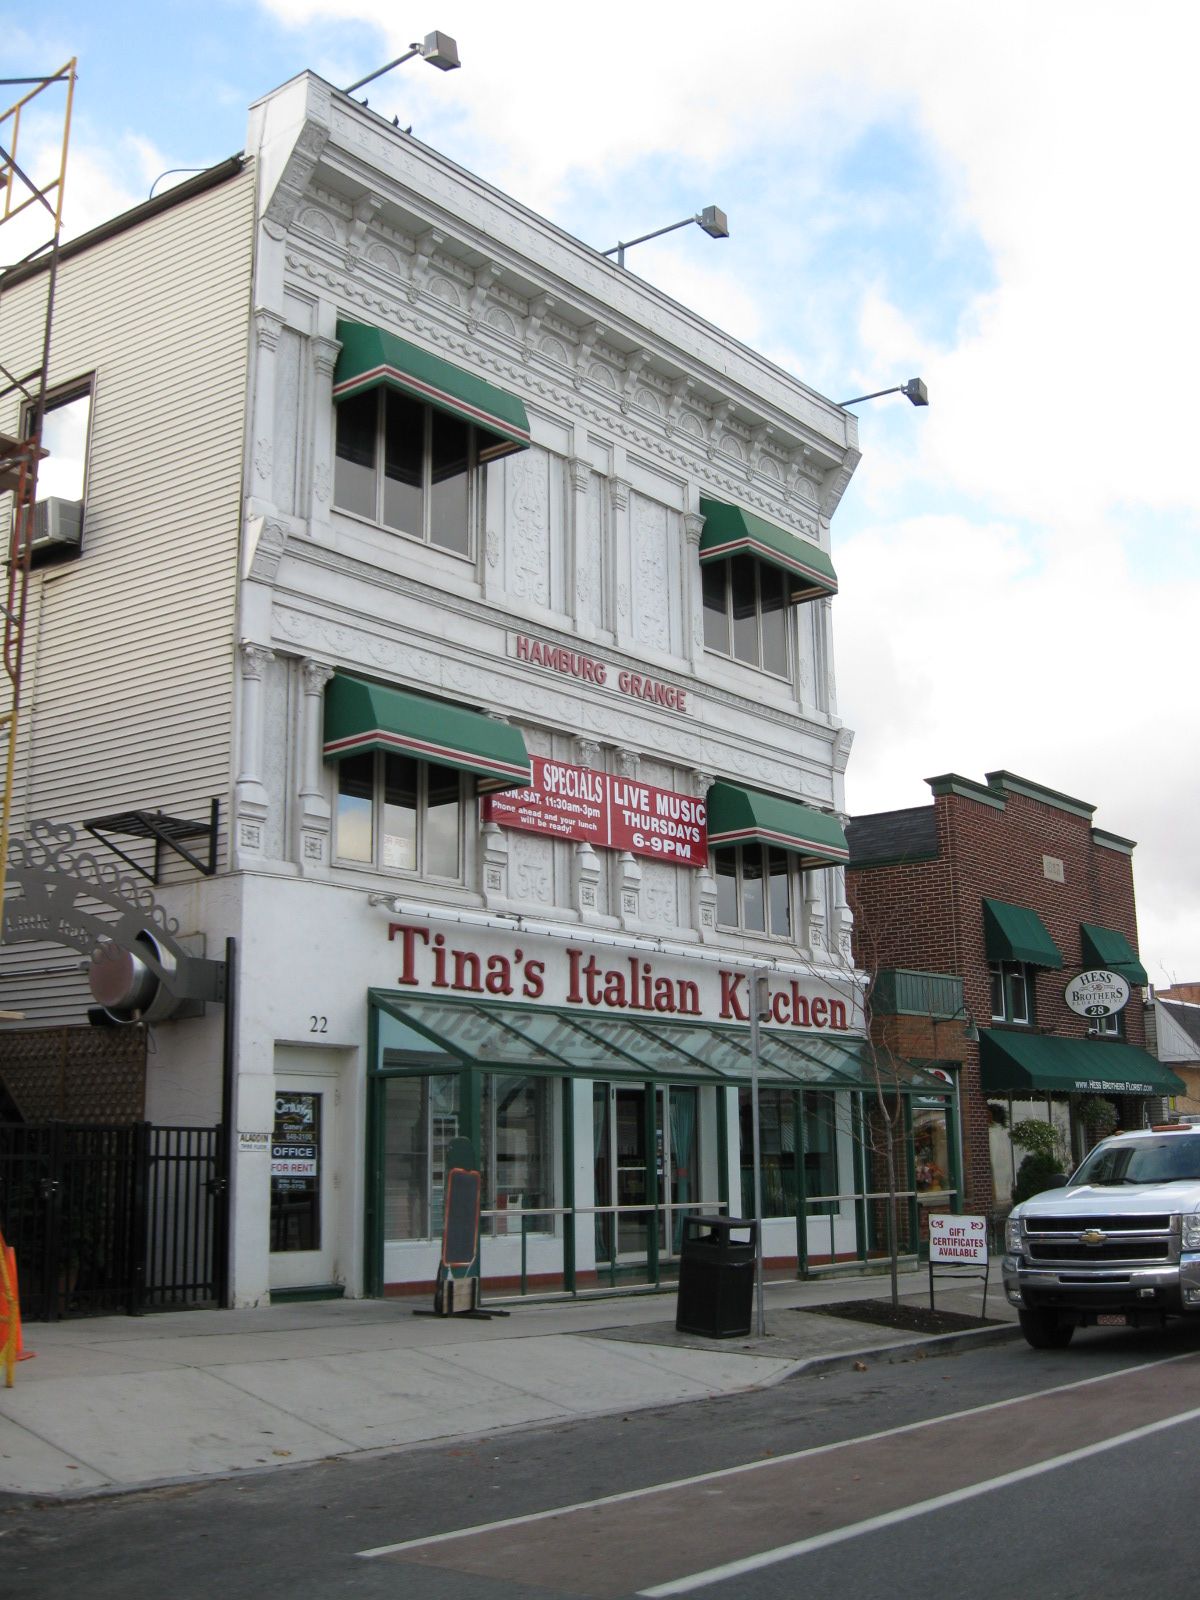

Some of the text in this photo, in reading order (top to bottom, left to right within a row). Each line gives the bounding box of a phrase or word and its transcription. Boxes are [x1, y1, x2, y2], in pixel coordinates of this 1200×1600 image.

[516, 635, 687, 712] HAMBURG GRANGE
[543, 763, 603, 804] SPECIALS
[545, 796, 601, 818] 11:30am-3pm
[614, 782, 706, 826] LIVE MUSIC
[491, 800, 597, 831] Phone ahead and your lunch
[521, 816, 572, 834] will be ready!
[622, 810, 700, 843] THURSDAYS
[632, 832, 691, 859] 6-9PM
[388, 922, 546, 998] Tina's
[565, 947, 703, 1016] Italian
[1079, 972, 1113, 985] HESS
[1072, 987, 1123, 1002] BROTHERS
[1090, 1006, 1104, 1015] 28
[310, 1015, 328, 1033] 22
[273, 1147, 313, 1157] OFFICE
[271, 1163, 314, 1172] FOR RENT
[949, 1228, 965, 1237] GIFT
[932, 1237, 984, 1247] CERTIFICATES
[939, 1248, 978, 1257] AVAILABLE
